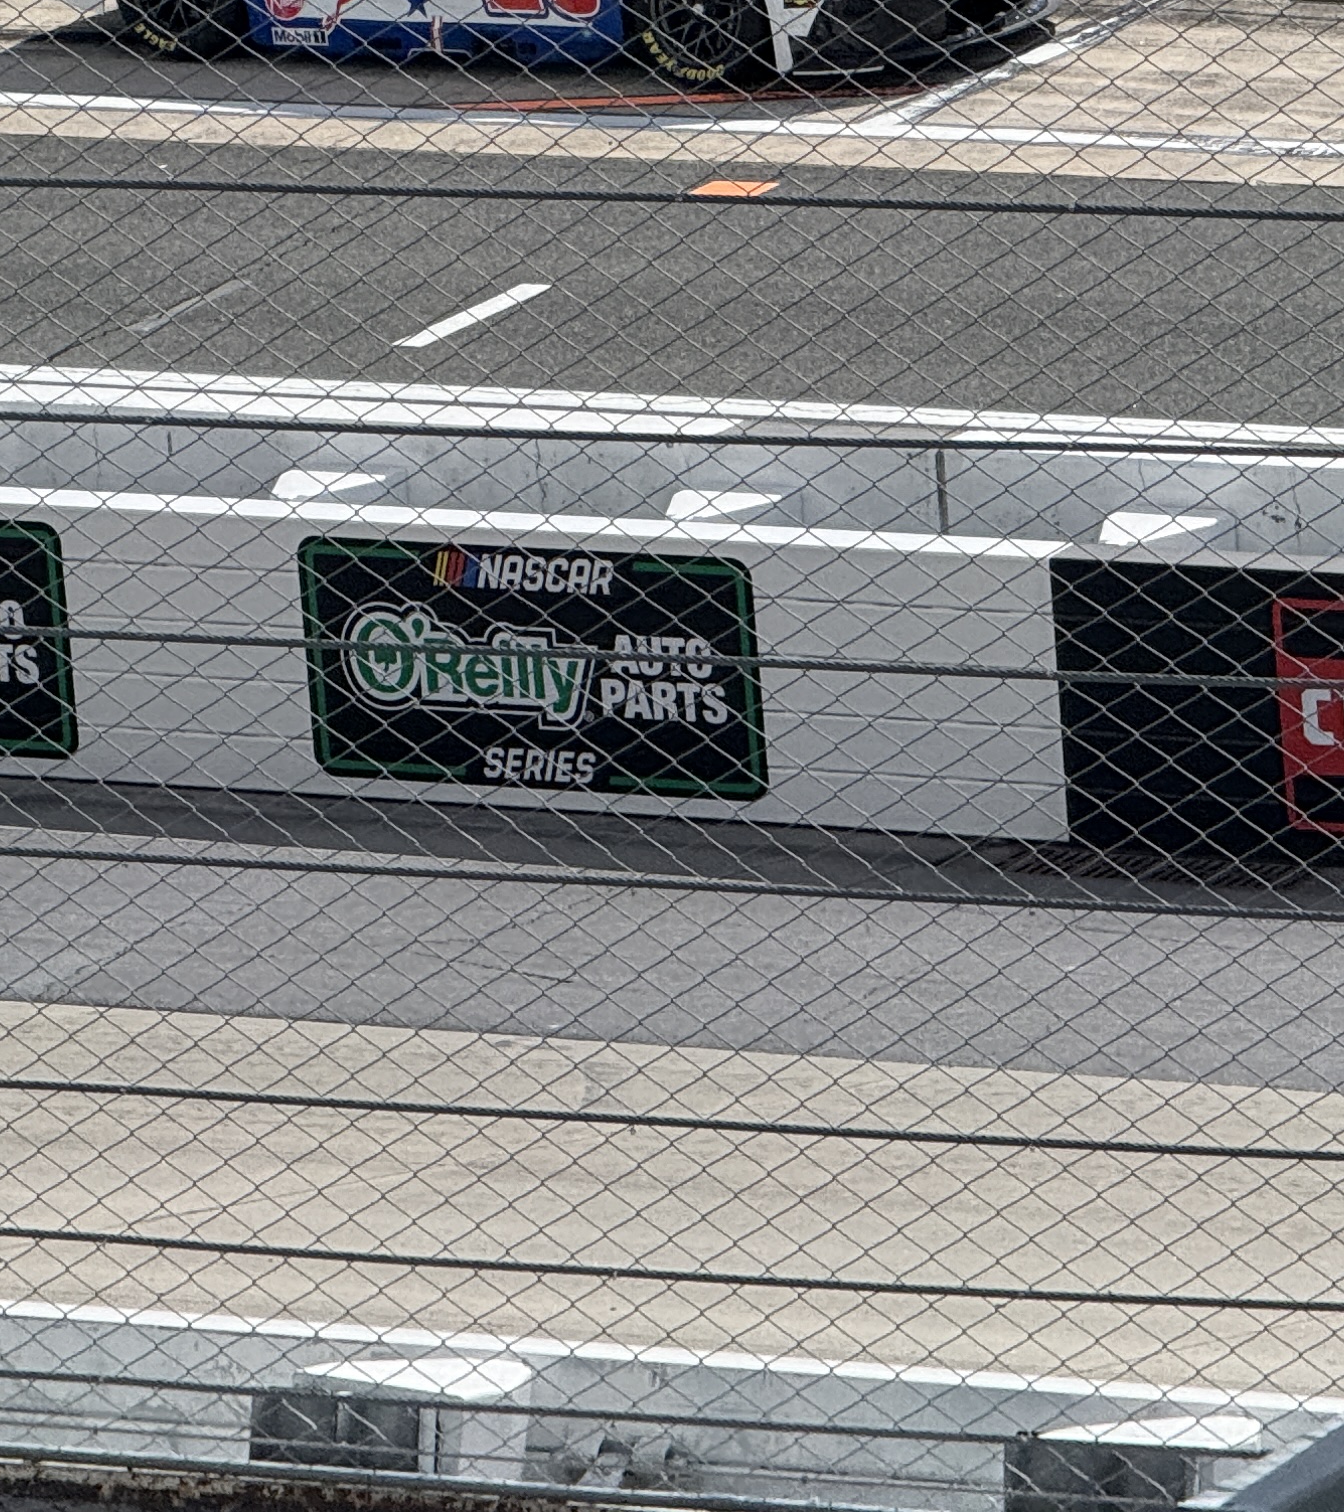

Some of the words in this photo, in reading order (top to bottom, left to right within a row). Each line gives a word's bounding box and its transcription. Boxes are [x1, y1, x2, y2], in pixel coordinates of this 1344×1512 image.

[478, 553, 613, 595] NASCAR
[354, 610, 581, 718] O'Reilly
[611, 634, 712, 677] AUTO
[601, 679, 726, 724] PARTS
[483, 747, 596, 784] SERIES
